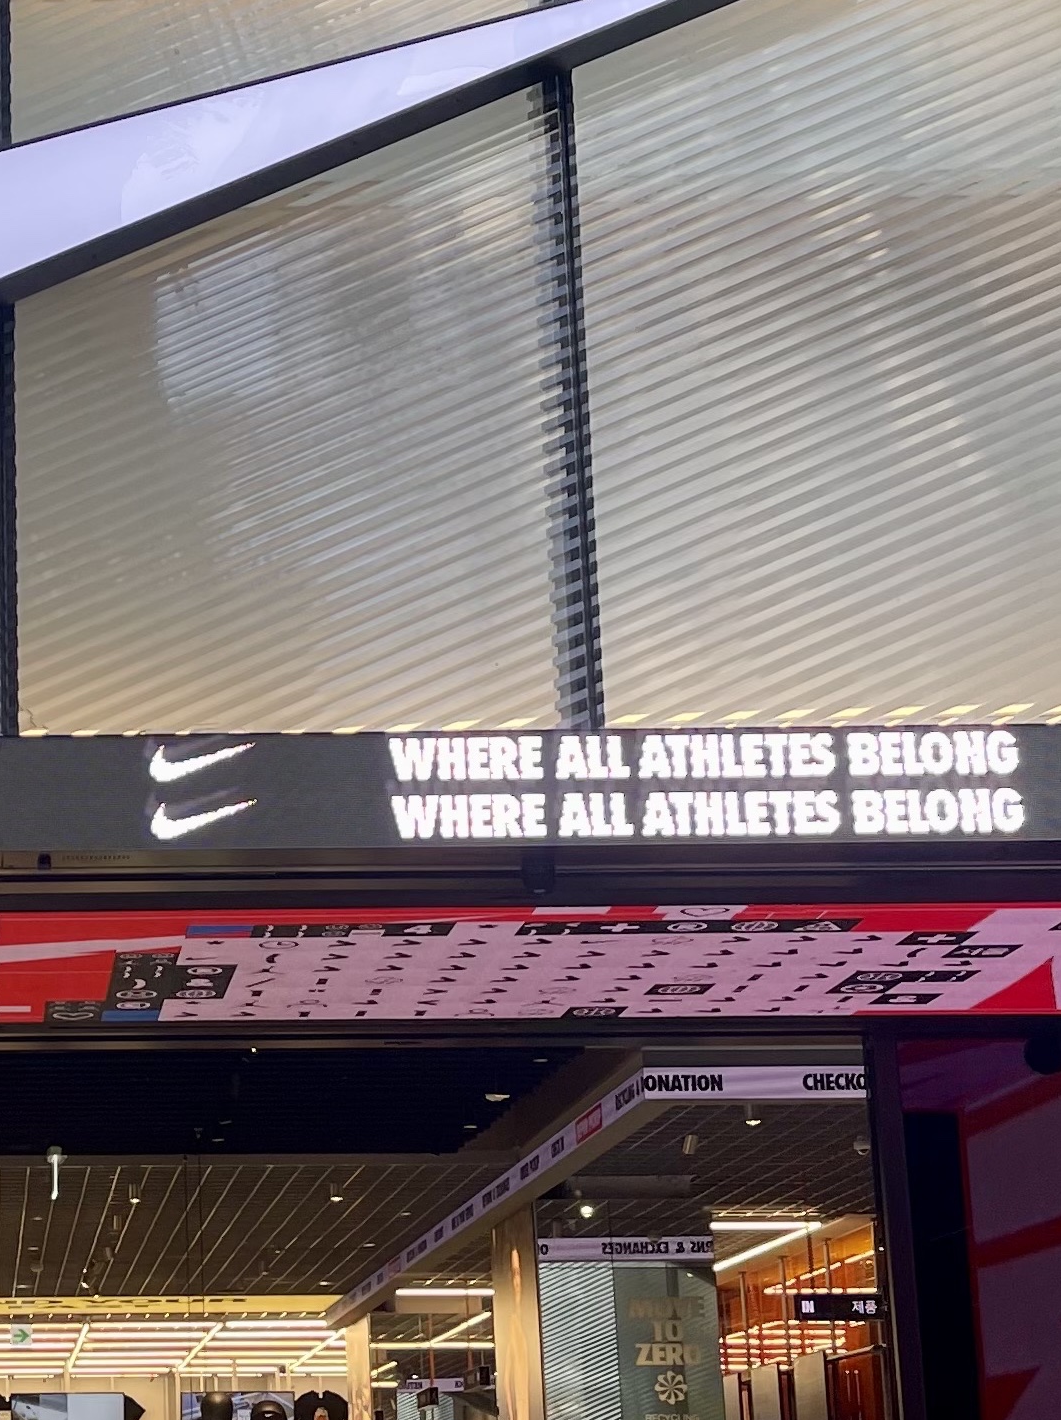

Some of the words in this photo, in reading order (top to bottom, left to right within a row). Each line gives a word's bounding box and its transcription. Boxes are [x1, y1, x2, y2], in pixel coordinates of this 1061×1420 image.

[390, 734, 544, 781] WHERE
[556, 733, 630, 779] ALL
[640, 733, 836, 778] ATHLETES
[847, 731, 1019, 776] BELONG
[392, 793, 547, 838] WHERE
[559, 792, 634, 837] ALL
[642, 790, 841, 836] ATHLETES
[851, 788, 1025, 834] BELONG
[653, 1320, 683, 1342] TO
[635, 1343, 700, 1366] ZERO
